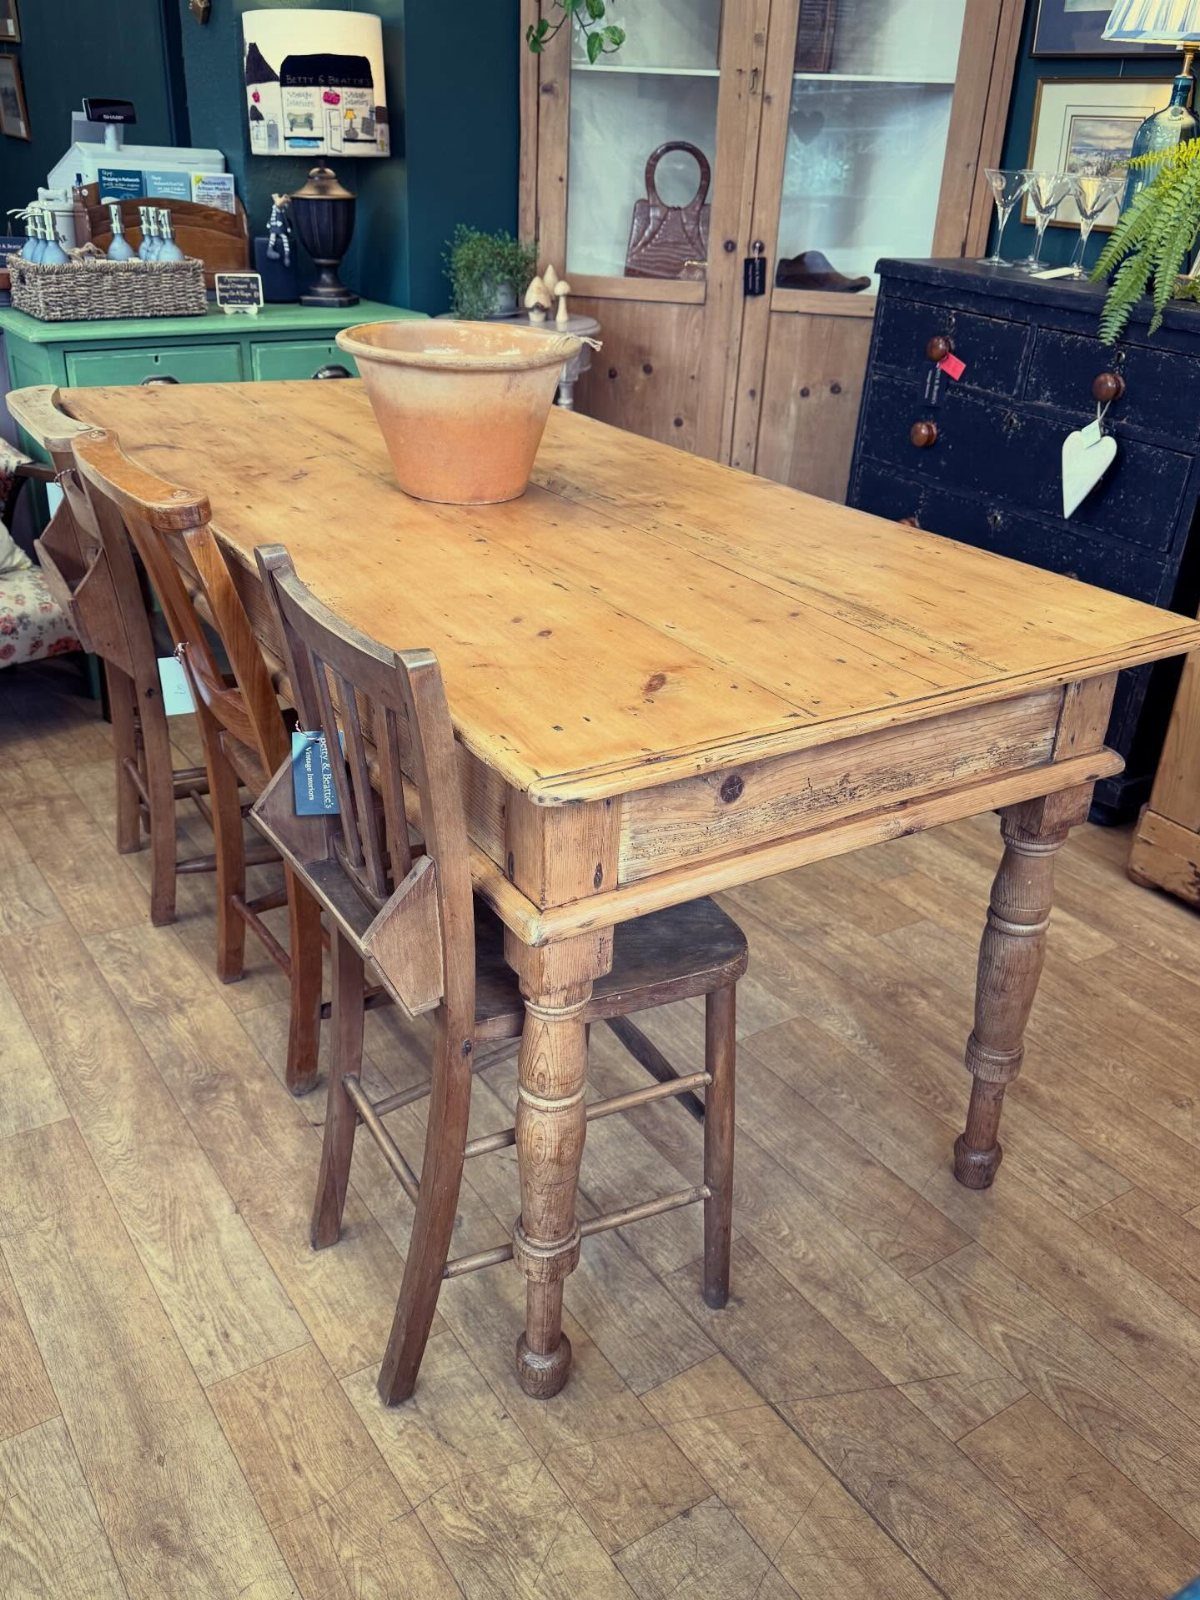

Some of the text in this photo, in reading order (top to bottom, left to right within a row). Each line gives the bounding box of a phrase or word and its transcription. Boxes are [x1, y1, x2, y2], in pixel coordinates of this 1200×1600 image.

[286, 75, 314, 84] BETTY
[322, 762, 331, 773] &
[307, 773, 315, 801] Interiors
[322, 773, 335, 809] Beattie's
